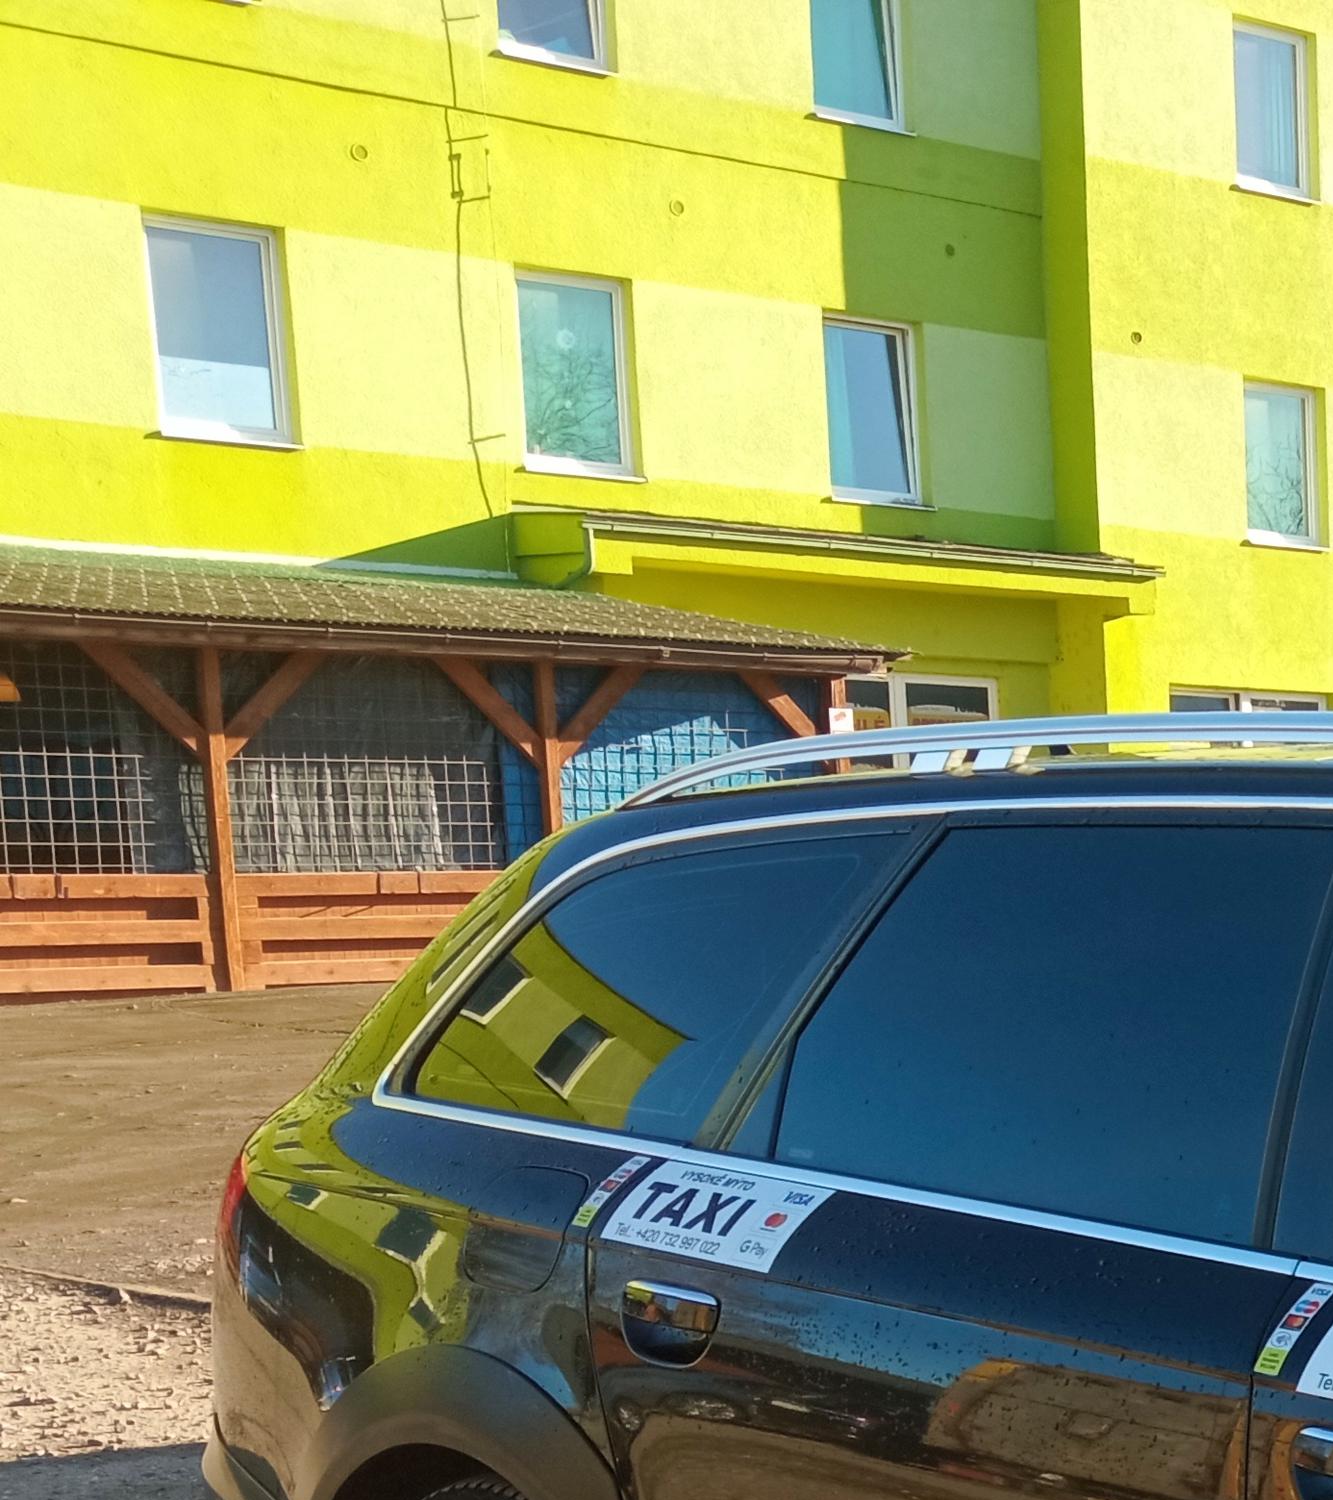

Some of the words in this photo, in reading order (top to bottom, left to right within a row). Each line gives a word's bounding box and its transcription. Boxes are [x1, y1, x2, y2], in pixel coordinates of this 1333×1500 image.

[632, 1181, 758, 1237] TAXI
[783, 1191, 816, 1206] VISA
[635, 1226, 660, 1244] +420
[660, 1231, 681, 1248] 732
[681, 1235, 701, 1251] 997
[700, 1240, 721, 1256] 022
